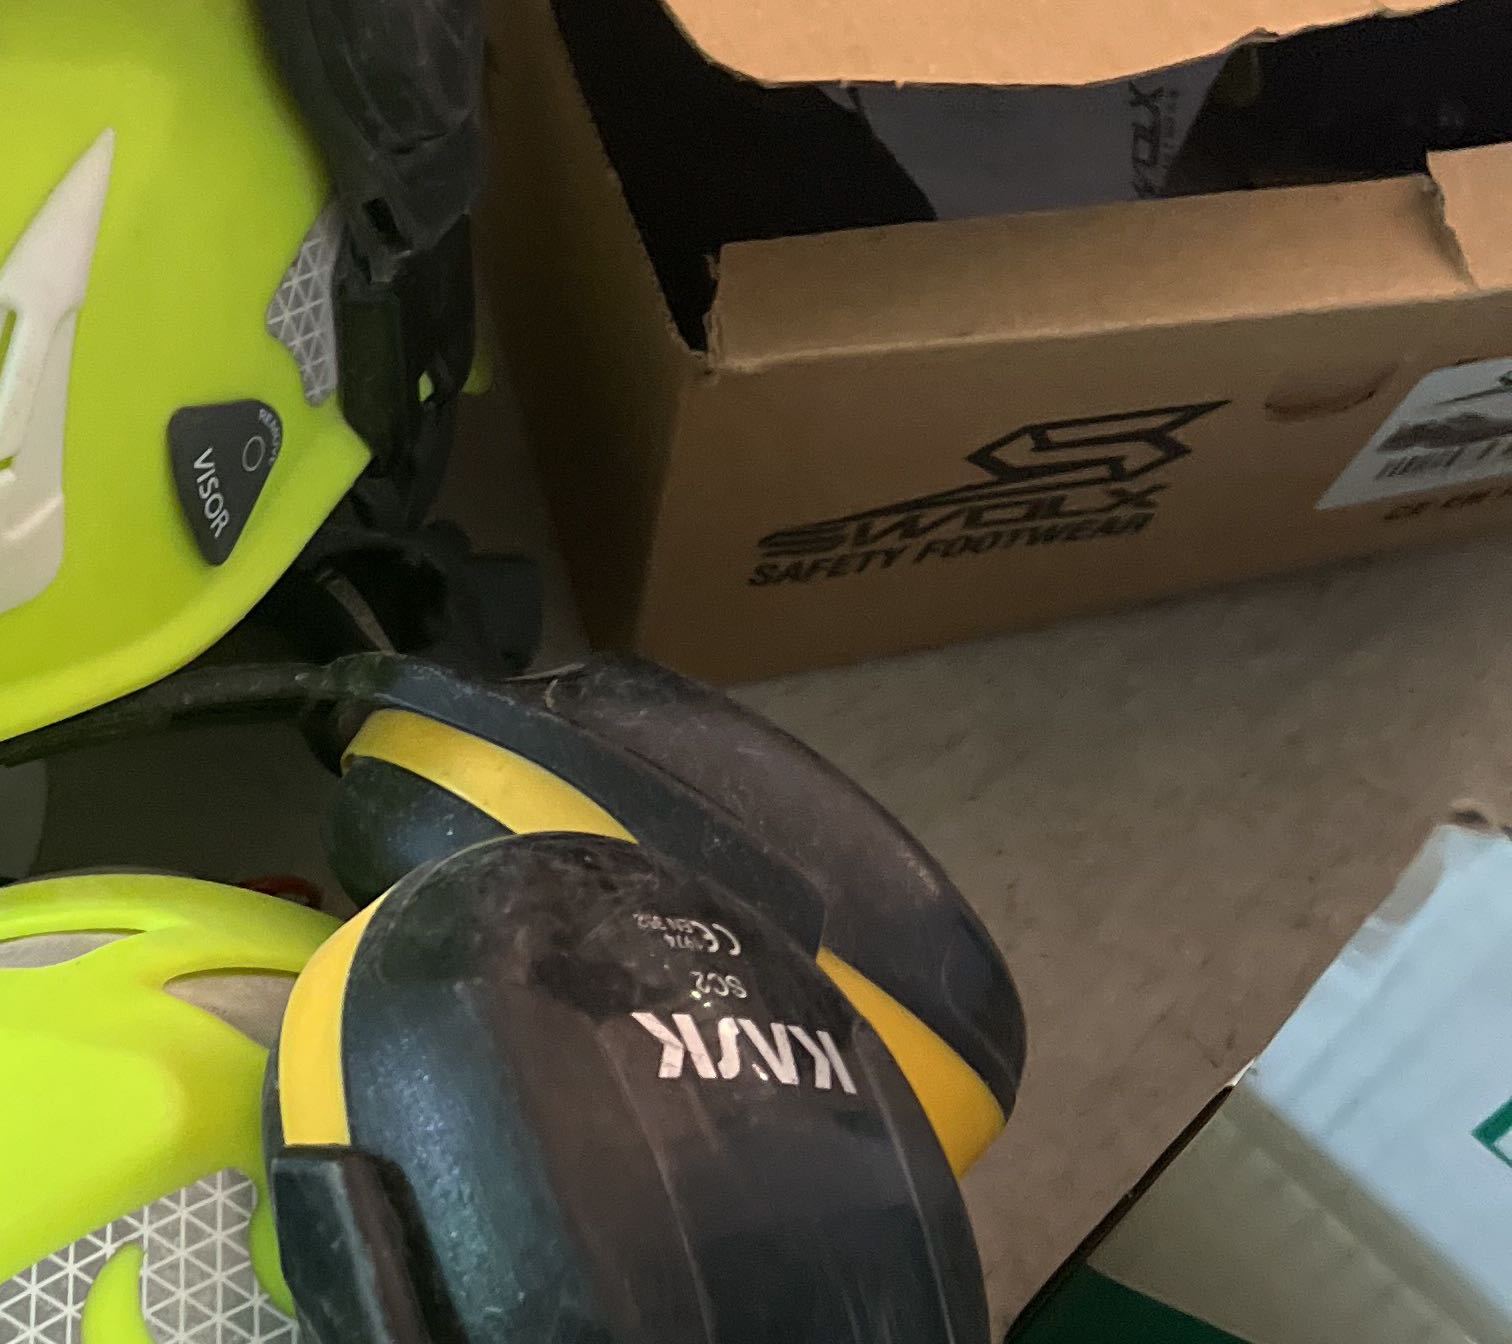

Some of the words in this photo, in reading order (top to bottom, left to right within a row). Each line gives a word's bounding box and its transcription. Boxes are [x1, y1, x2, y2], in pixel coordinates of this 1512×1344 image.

[193, 446, 230, 539] VISOR
[747, 545, 909, 587] SAFETY
[912, 511, 1158, 565] FOOTWEAR
[630, 1011, 858, 1095] KASK
